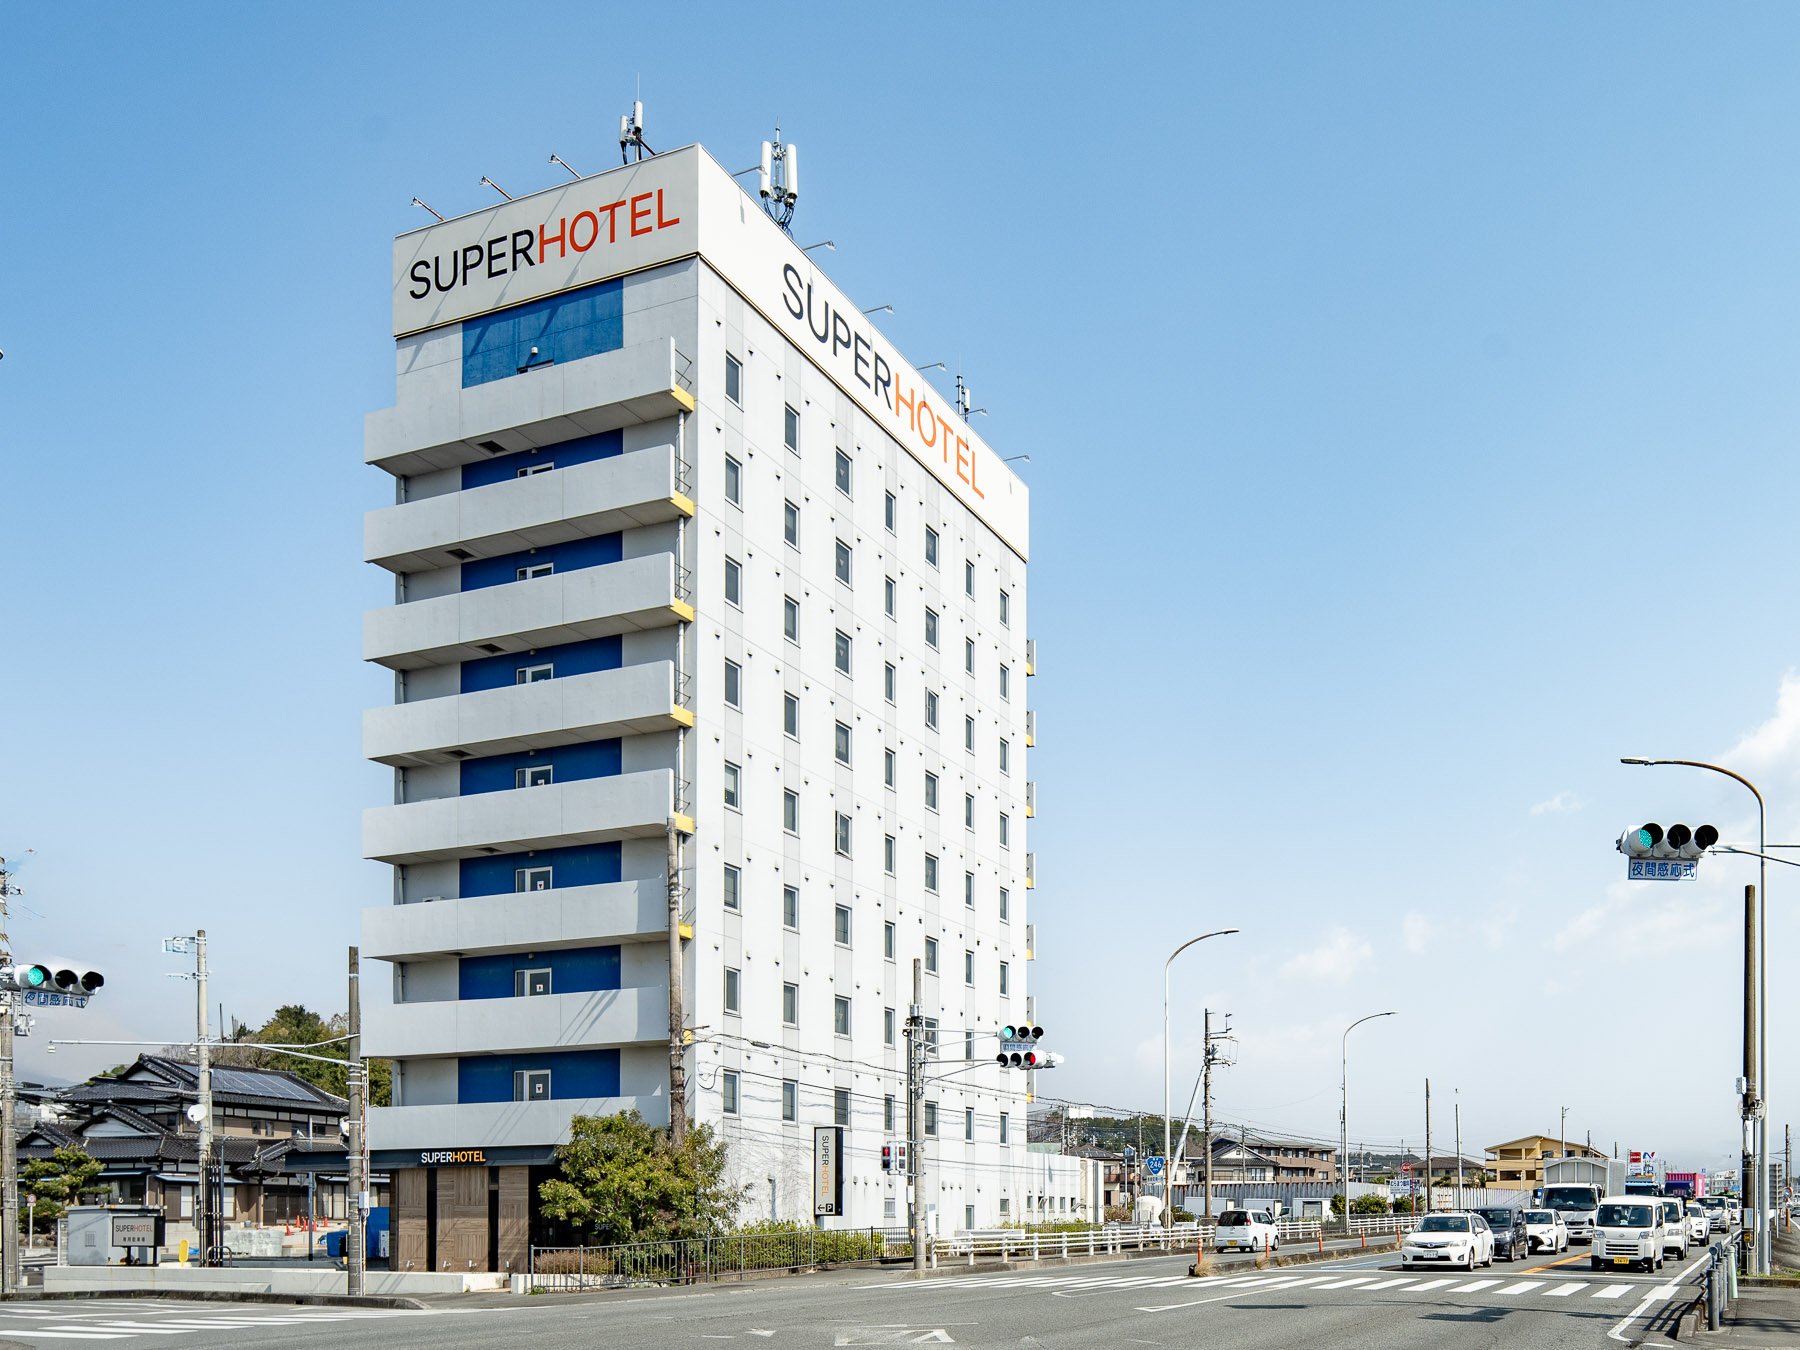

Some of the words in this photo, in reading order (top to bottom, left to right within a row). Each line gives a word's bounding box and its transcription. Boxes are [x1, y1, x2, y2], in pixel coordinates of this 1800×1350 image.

[409, 189, 680, 299] SUPERHOTEL
[782, 263, 985, 500] SUPERHOTEL
[1632, 862, 1695, 878] 夜間感応式
[421, 1150, 486, 1163] SUPERHOTEL
[1149, 1160, 1162, 1168] 246
[821, 1135, 830, 1197] SUPERHOTEL
[115, 1224, 153, 1233] SUPERHOTEL
